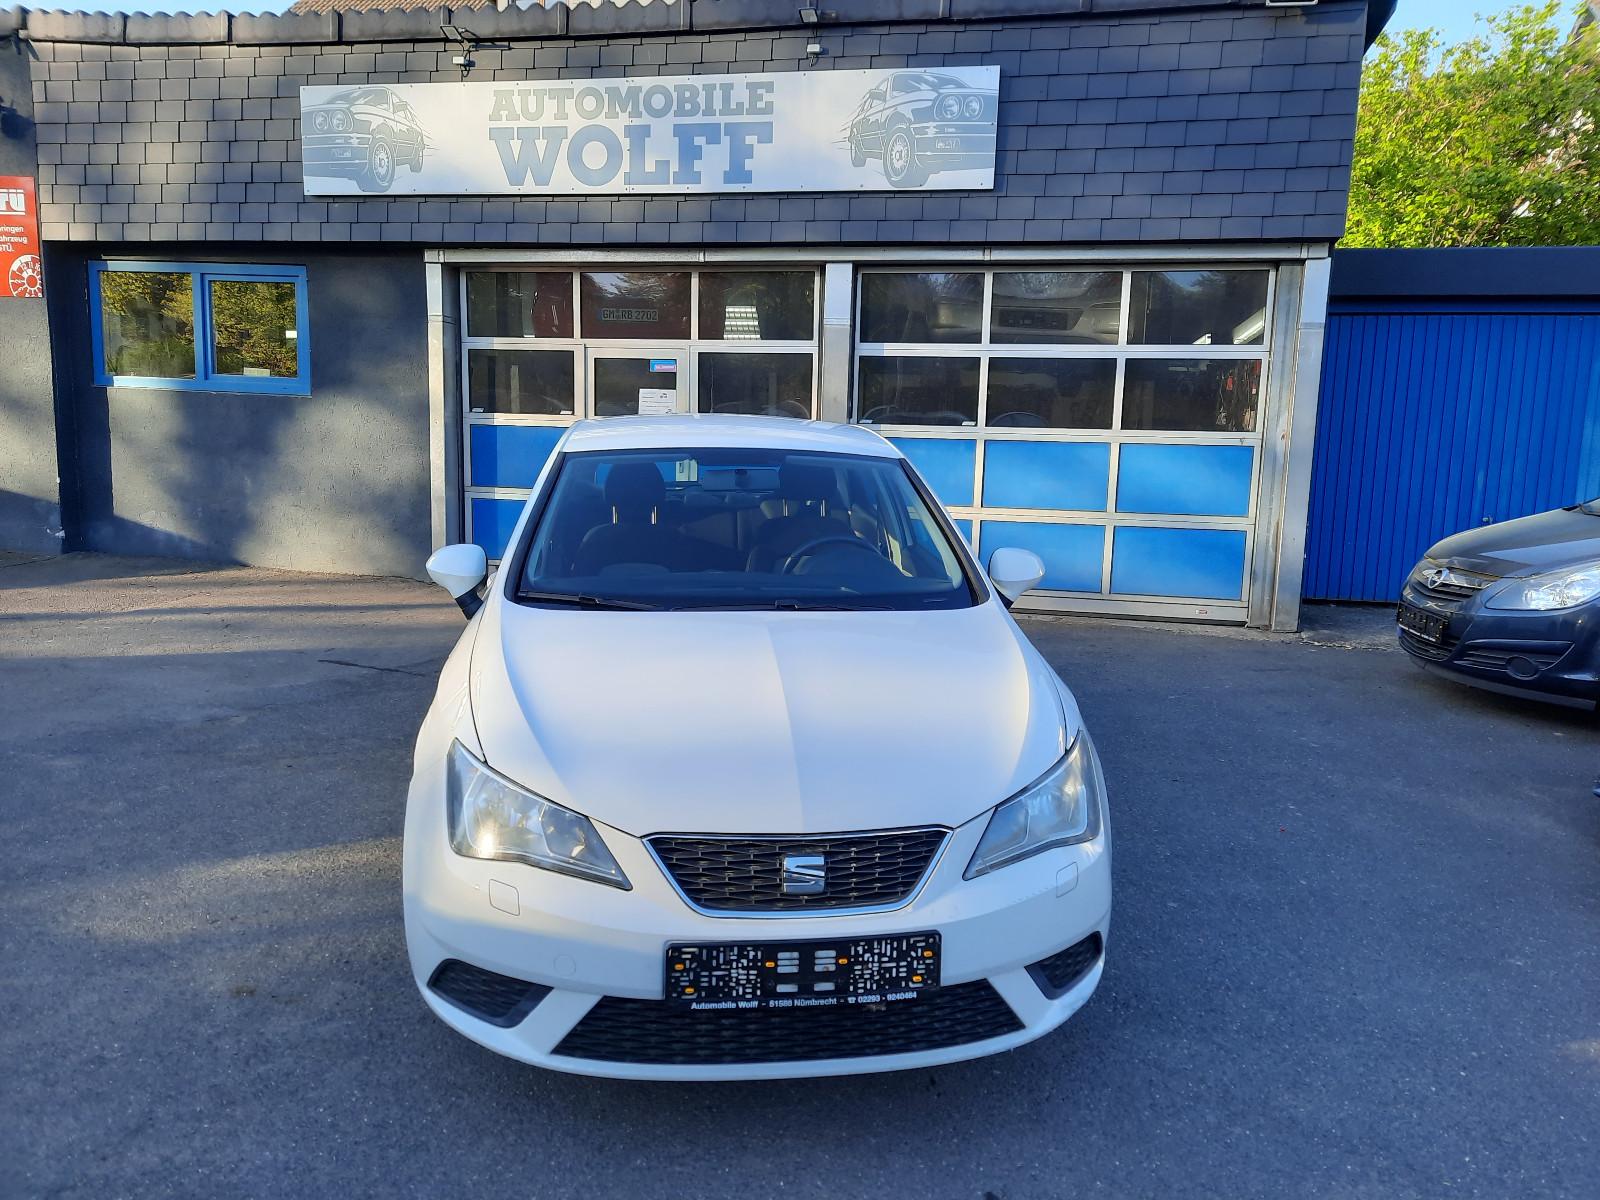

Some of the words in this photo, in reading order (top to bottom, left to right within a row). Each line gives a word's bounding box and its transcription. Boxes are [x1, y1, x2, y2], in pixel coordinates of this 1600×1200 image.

[489, 81, 774, 122] AUTOMOBILE
[489, 122, 773, 186] WOLFF
[0, 224, 24, 234] ringen
[603, 309, 615, 319] GM
[635, 310, 658, 321] 2702
[691, 1001, 737, 1010] Automobile
[738, 1000, 759, 1009] Wolff
[794, 997, 838, 1007] Nümbrecht
